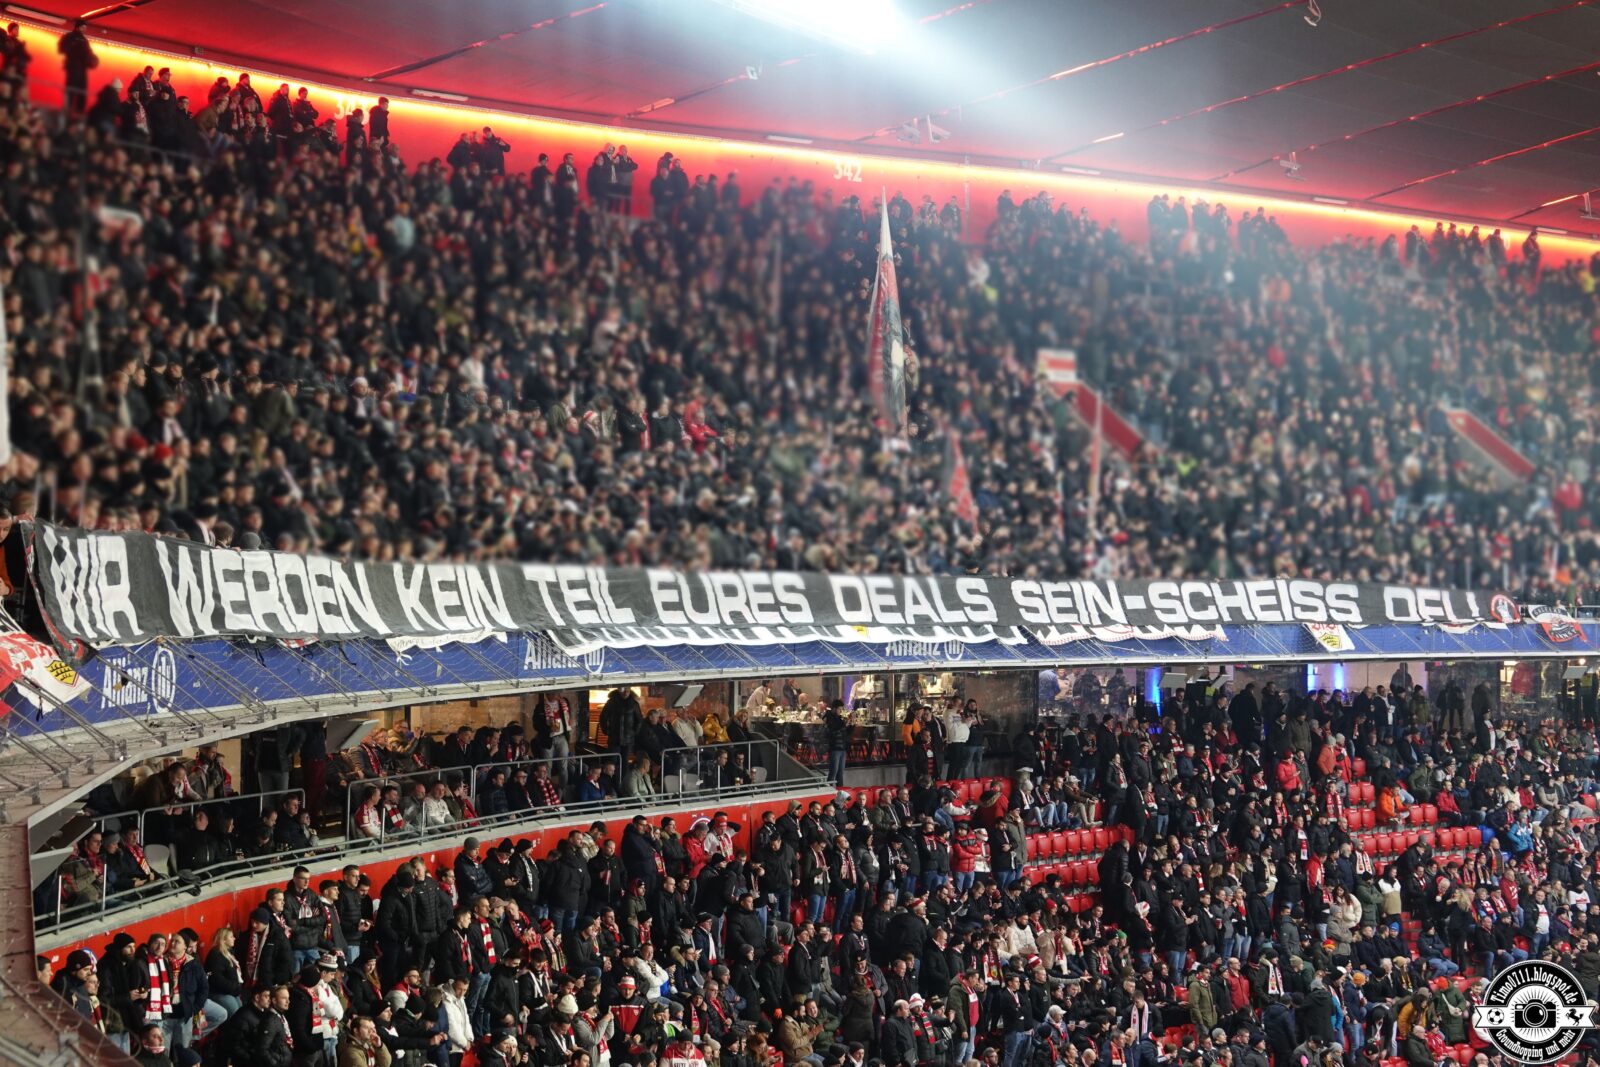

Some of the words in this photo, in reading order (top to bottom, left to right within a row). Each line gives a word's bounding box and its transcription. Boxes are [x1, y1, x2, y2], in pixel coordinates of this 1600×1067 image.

[833, 158, 862, 183] 342
[43, 525, 143, 639] WIR
[156, 540, 392, 638] WERDEN
[392, 563, 518, 632] KEIN
[523, 564, 637, 626] TEIL
[646, 569, 815, 625] EURES
[828, 574, 997, 625] DEALS
[1011, 578, 1360, 626] SEIN-SCHEISS
